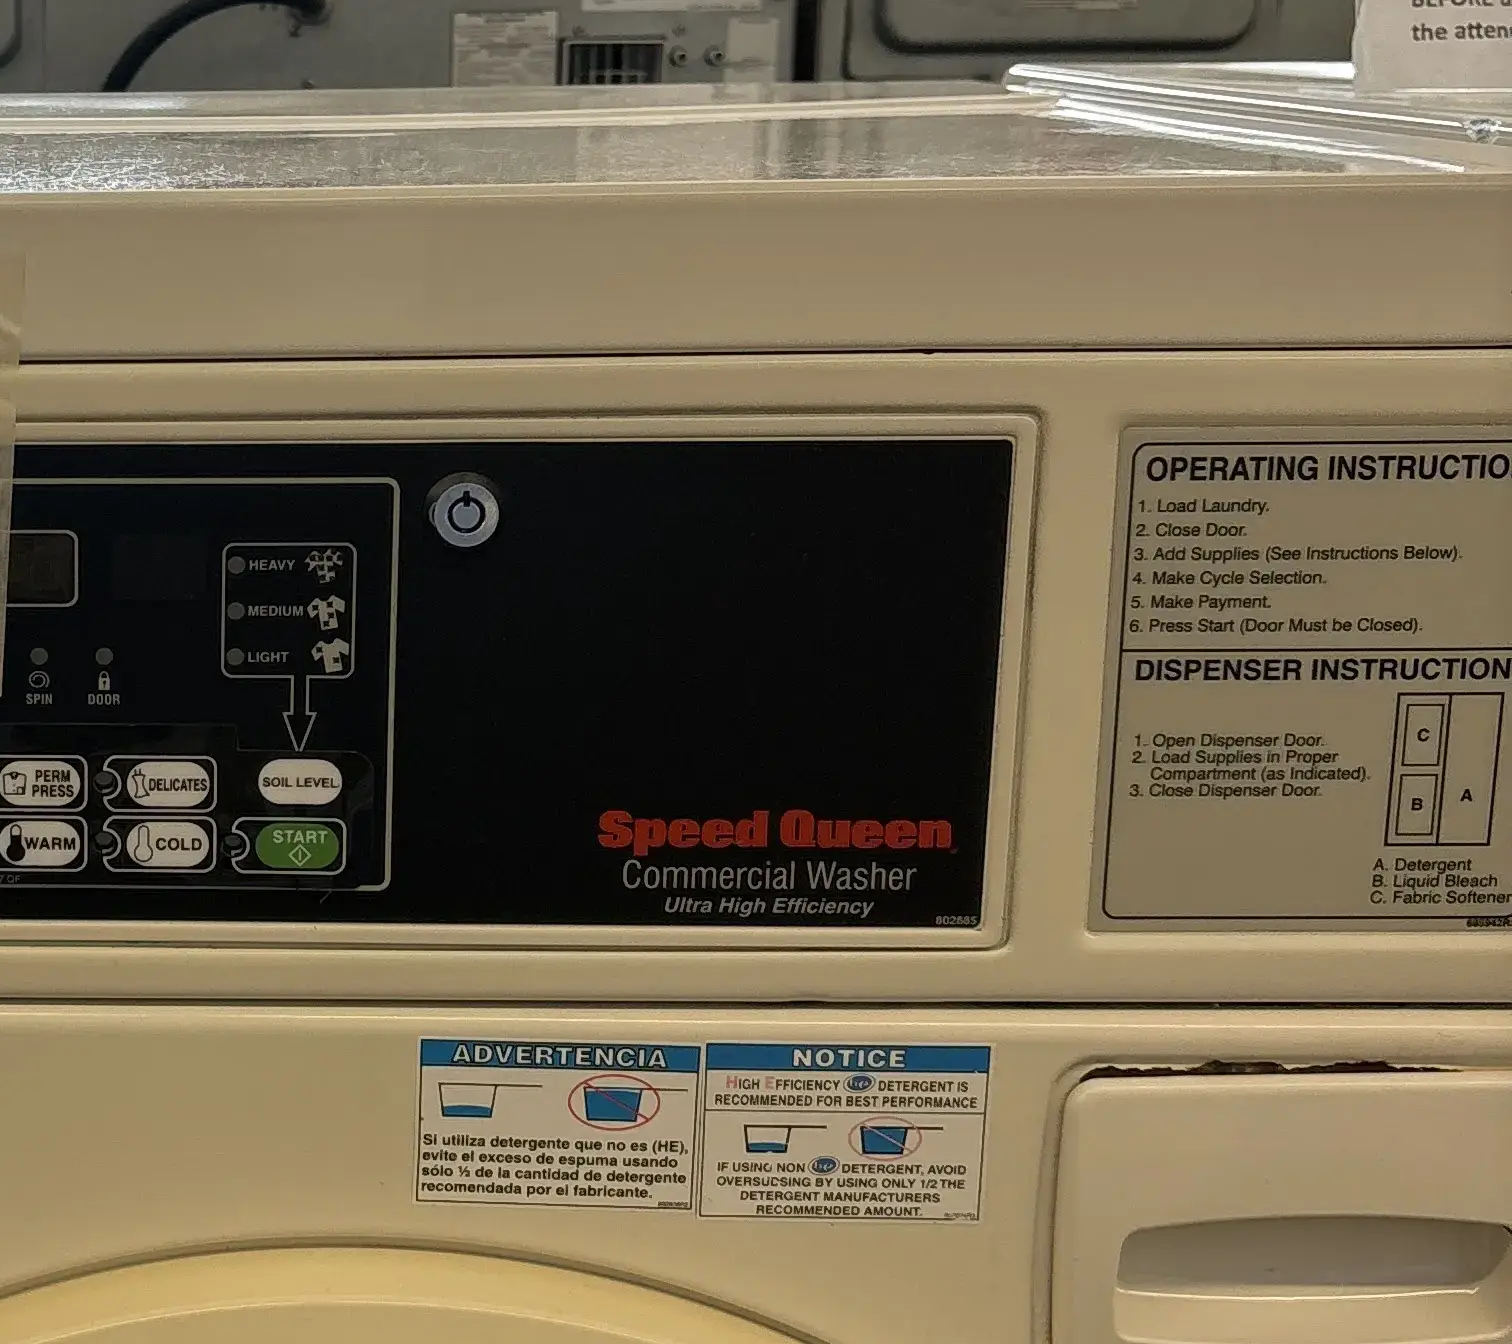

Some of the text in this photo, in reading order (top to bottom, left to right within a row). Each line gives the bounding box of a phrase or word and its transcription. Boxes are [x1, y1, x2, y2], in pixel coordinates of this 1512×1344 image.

[1412, 22, 1448, 41] the
[249, 560, 295, 570] HEAVY
[248, 606, 303, 616] MEDIUM
[248, 652, 289, 662] LIGHT
[1135, 659, 1302, 681] DISPENSER
[26, 694, 52, 704] SPIN
[88, 694, 120, 705] DOOR
[36, 770, 70, 782] PERM
[1151, 766, 1370, 782] Compartment (as Indicated).
[148, 777, 208, 794] DELICATES
[263, 777, 340, 788] SOIL LEVEL
[32, 784, 76, 799] PRESS
[1129, 783, 1322, 799] 3. Close Dispenser Door.
[272, 829, 328, 845] START
[598, 809, 951, 856] Speed Queen
[24, 837, 75, 852] WARM
[156, 838, 202, 851] COLD
[1373, 858, 1472, 874] A. Detergent
[623, 860, 917, 890] Commercial Washer
[1372, 874, 1497, 890] B. Liquid Bleach
[665, 897, 874, 918] Ultra High Efficiency
[451, 1044, 666, 1068] ADVERTENCIA
[793, 1049, 905, 1067] NOTICE
[726, 1075, 760, 1091] HIGH
[764, 1075, 841, 1092] EFFICIENCY
[878, 1080, 955, 1093] DETERGENT
[957, 1080, 969, 1093] IS
[715, 1094, 978, 1108] RECOMMENDED FOR BEST PERFORMANCE
[423, 1134, 688, 1155] Si utiliza detergente que no es (HE),
[423, 1150, 678, 1168] evite el exceso de espuma usando
[422, 1166, 453, 1176] sólo
[475, 1167, 493, 1178] de
[498, 1168, 510, 1178] la
[515, 1169, 579, 1180] cantidad
[584, 1170, 601, 1181] de
[607, 1171, 686, 1185] detergente
[421, 1182, 652, 1198] recomendada por el fabricante.
[740, 1191, 940, 1203] DETERGENT MANUFACTURERS
[755, 1205, 922, 1216] RECOMMENDED AMOUNT.
